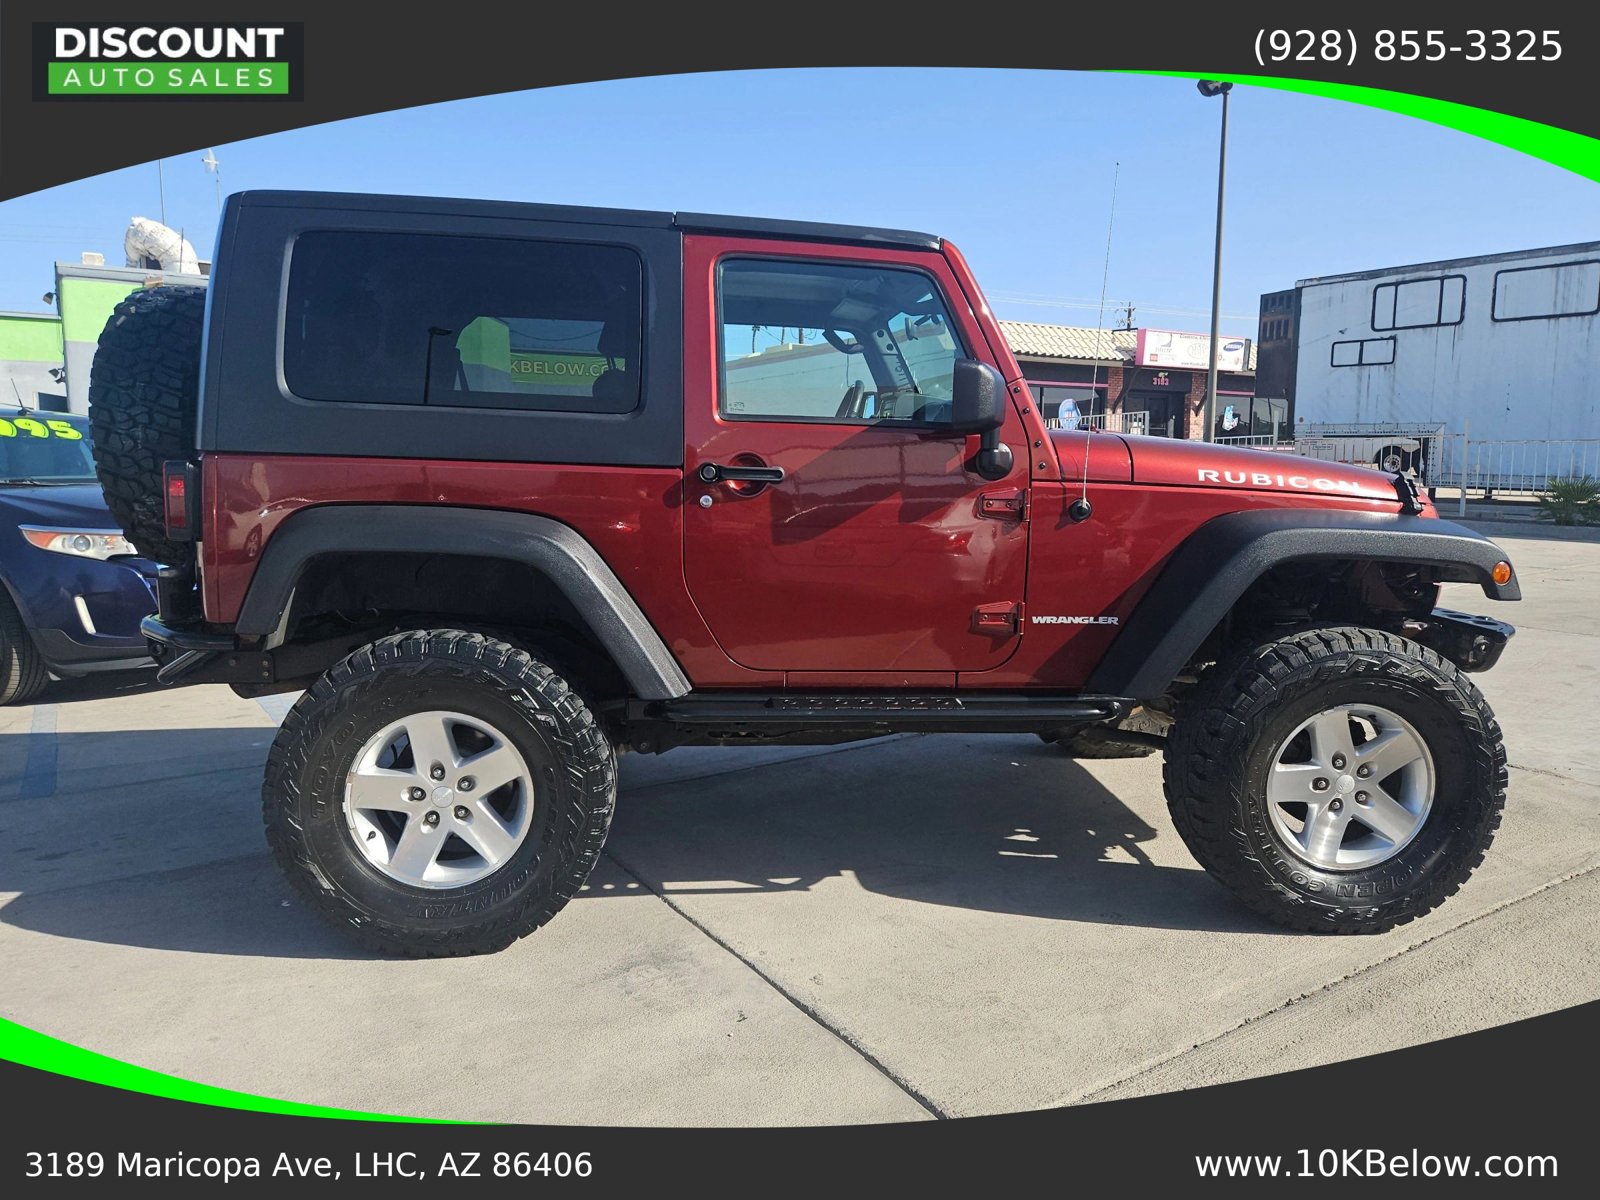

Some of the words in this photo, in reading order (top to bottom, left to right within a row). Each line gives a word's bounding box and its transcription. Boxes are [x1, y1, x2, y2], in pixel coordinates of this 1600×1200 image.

[1197, 468, 1361, 492] RUBICON
[1031, 615, 1119, 625] WRANGLER
[311, 721, 356, 818] TOYO
[1334, 872, 1411, 898] OPEN
